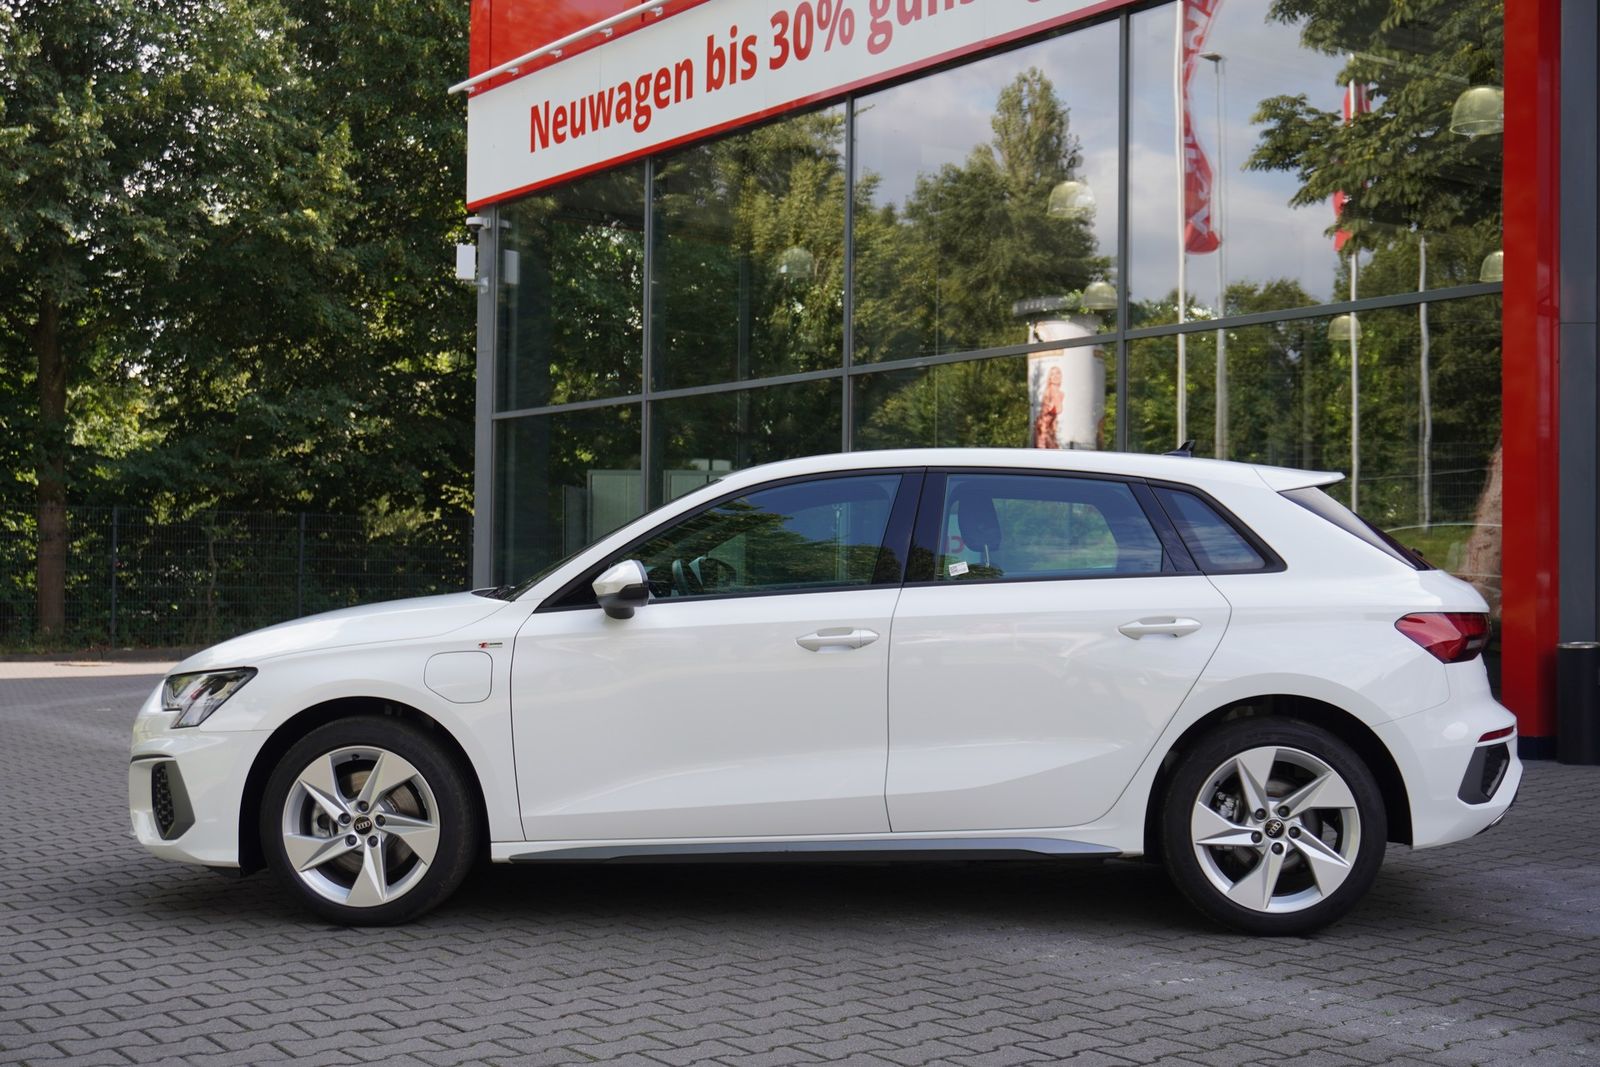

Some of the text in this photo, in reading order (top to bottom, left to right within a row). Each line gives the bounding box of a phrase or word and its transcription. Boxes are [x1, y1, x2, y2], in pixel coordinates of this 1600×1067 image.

[530, 58, 693, 153] Neuwagen
[706, 25, 759, 92] bis
[769, 0, 855, 70] 30%
